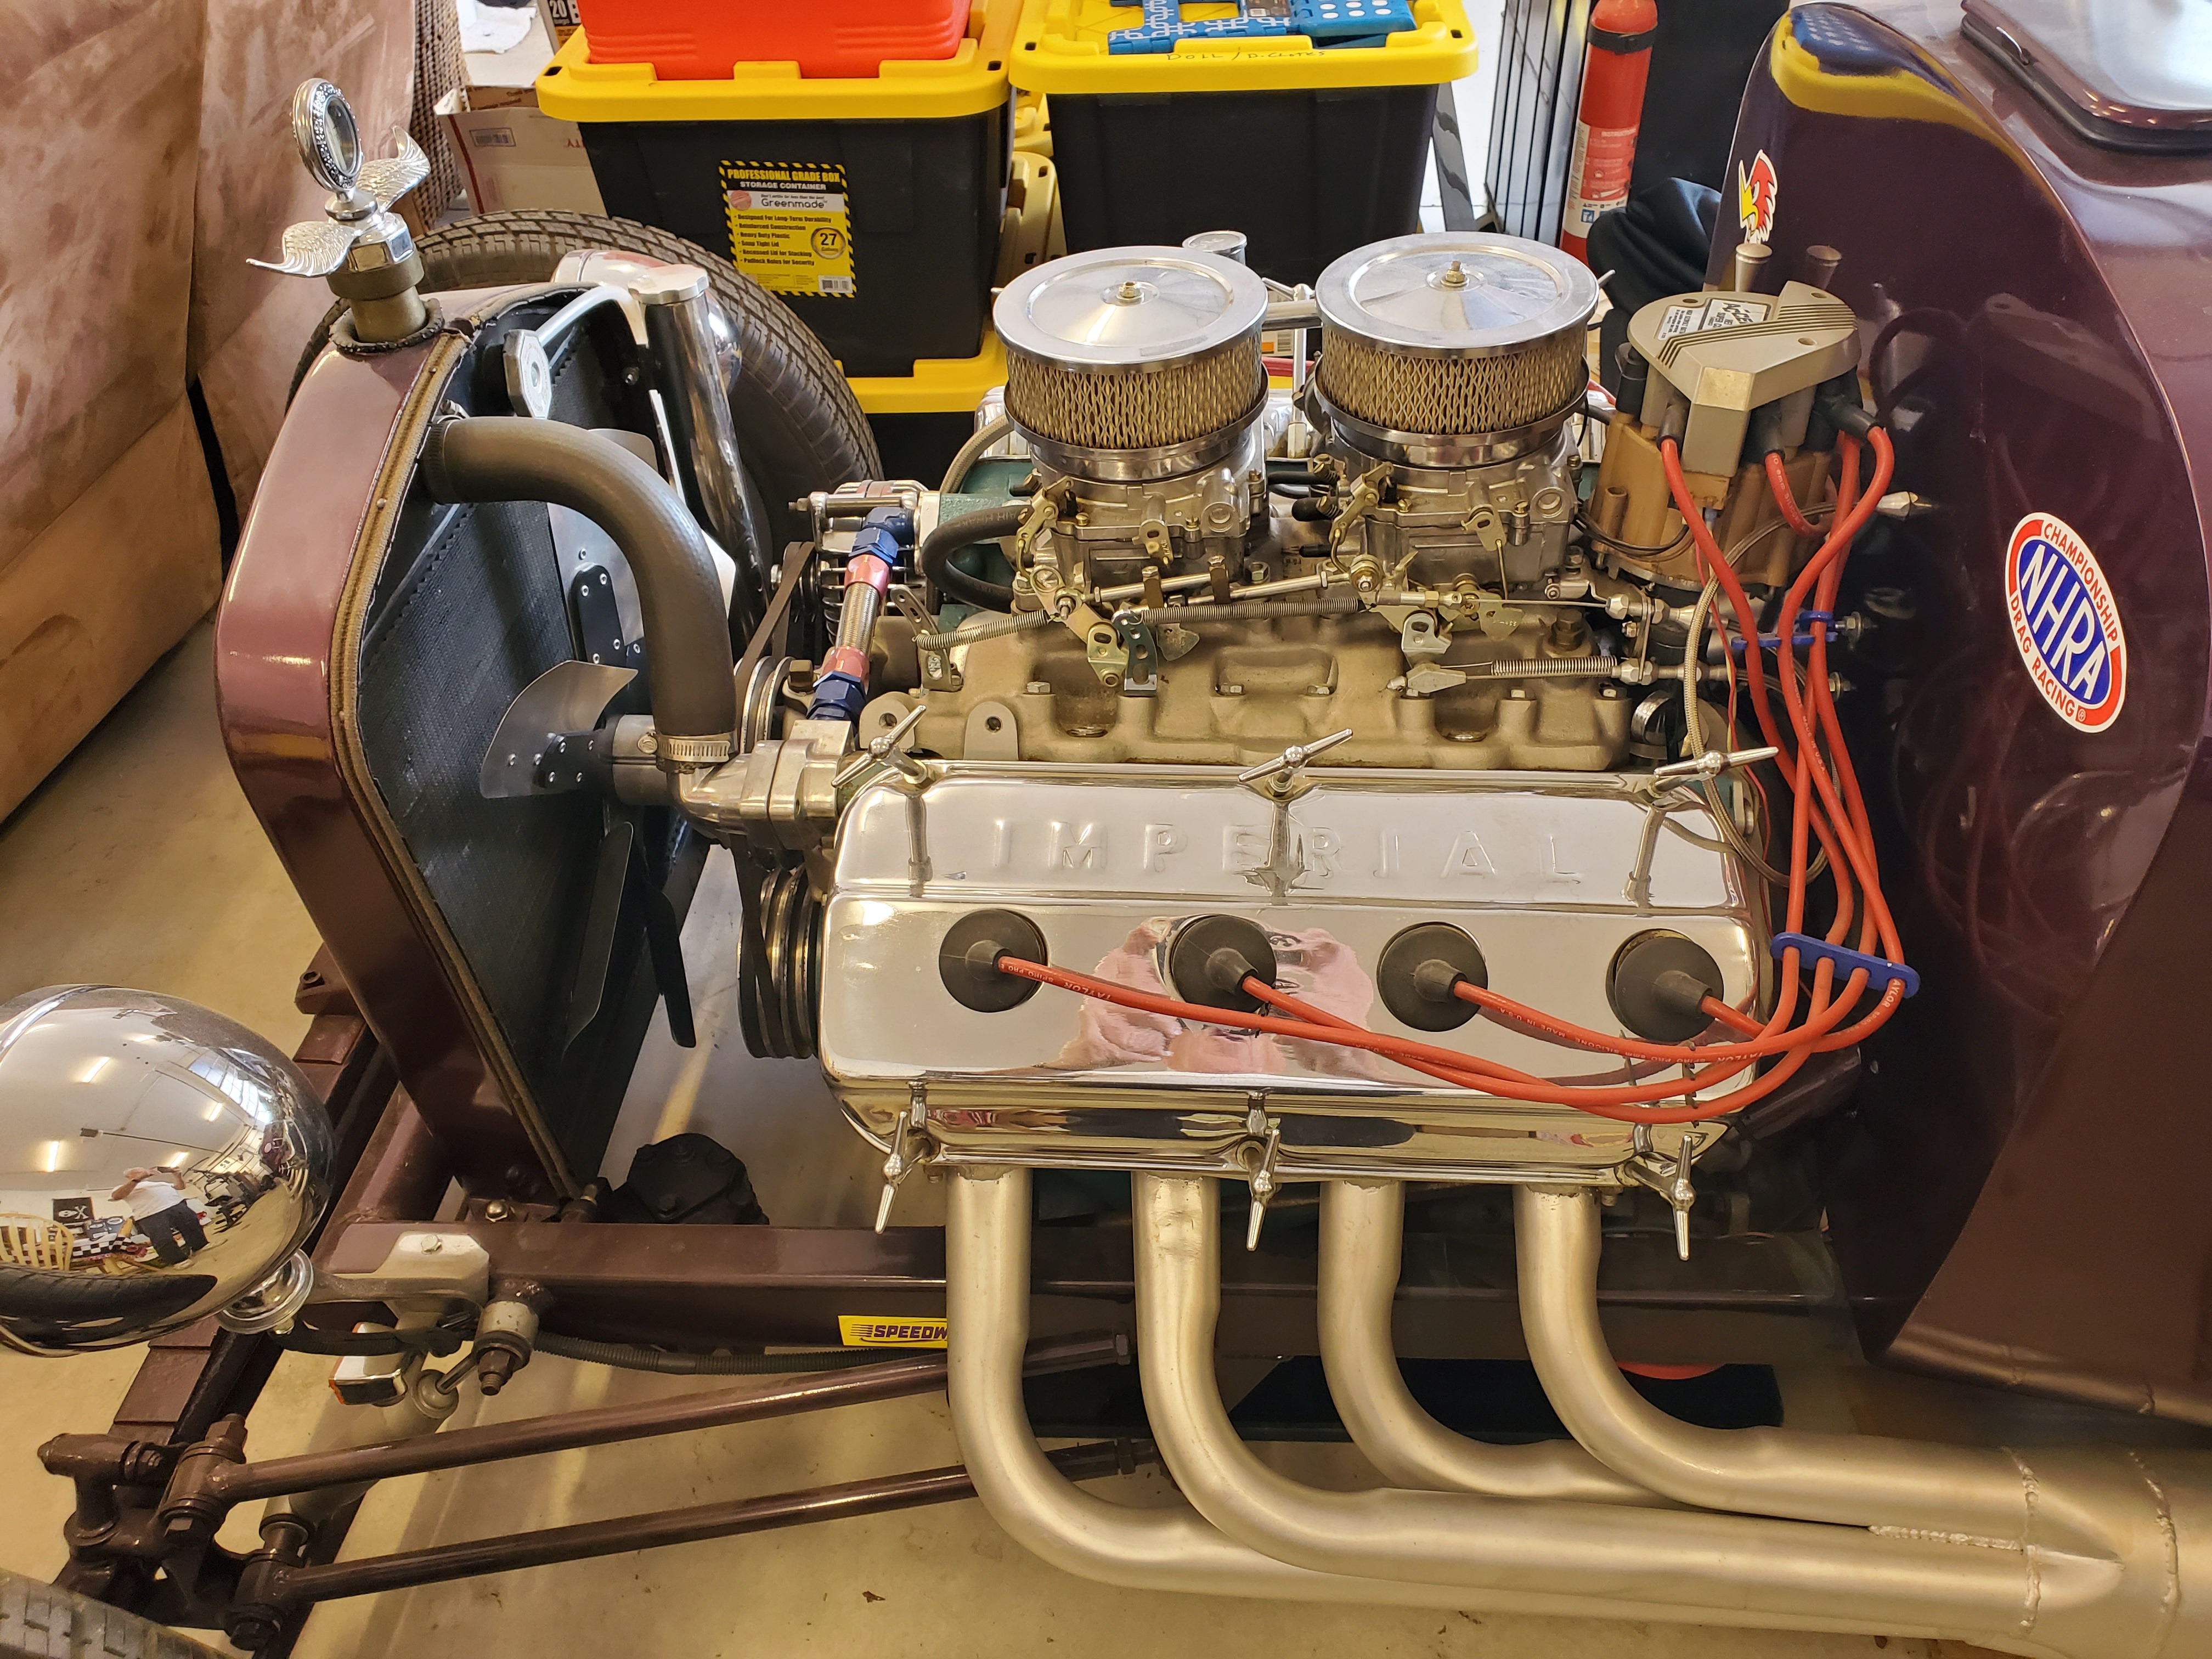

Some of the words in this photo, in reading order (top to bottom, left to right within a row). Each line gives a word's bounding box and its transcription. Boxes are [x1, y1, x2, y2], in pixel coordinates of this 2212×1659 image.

[549, 0, 567, 18] 20
[727, 169, 791, 181] PROFESSIONAL
[792, 171, 821, 182] GRADE
[822, 172, 840, 183] BOX
[761, 198, 825, 208] Greenmade
[820, 233, 837, 246] 27
[2044, 523, 2118, 642] CHAMPIONSHIP
[2021, 544, 2106, 699] NHRA
[2011, 596, 2032, 654] DRAG
[2032, 656, 2074, 716] RACING
[990, 819, 1582, 877] IMPERIAL
[1008, 966, 1024, 974] PRO
[1028, 971, 1054, 983] SPIRO
[1063, 981, 1111, 1001] TAYLOR
[1882, 979, 1901, 1008] AYLOR
[1541, 1024, 1565, 1037] MADE
[1576, 1038, 1620, 1053] SILICONE
[1717, 1052, 1763, 1062] TAYLOR
[874, 1325, 947, 1339] SPEEDW
